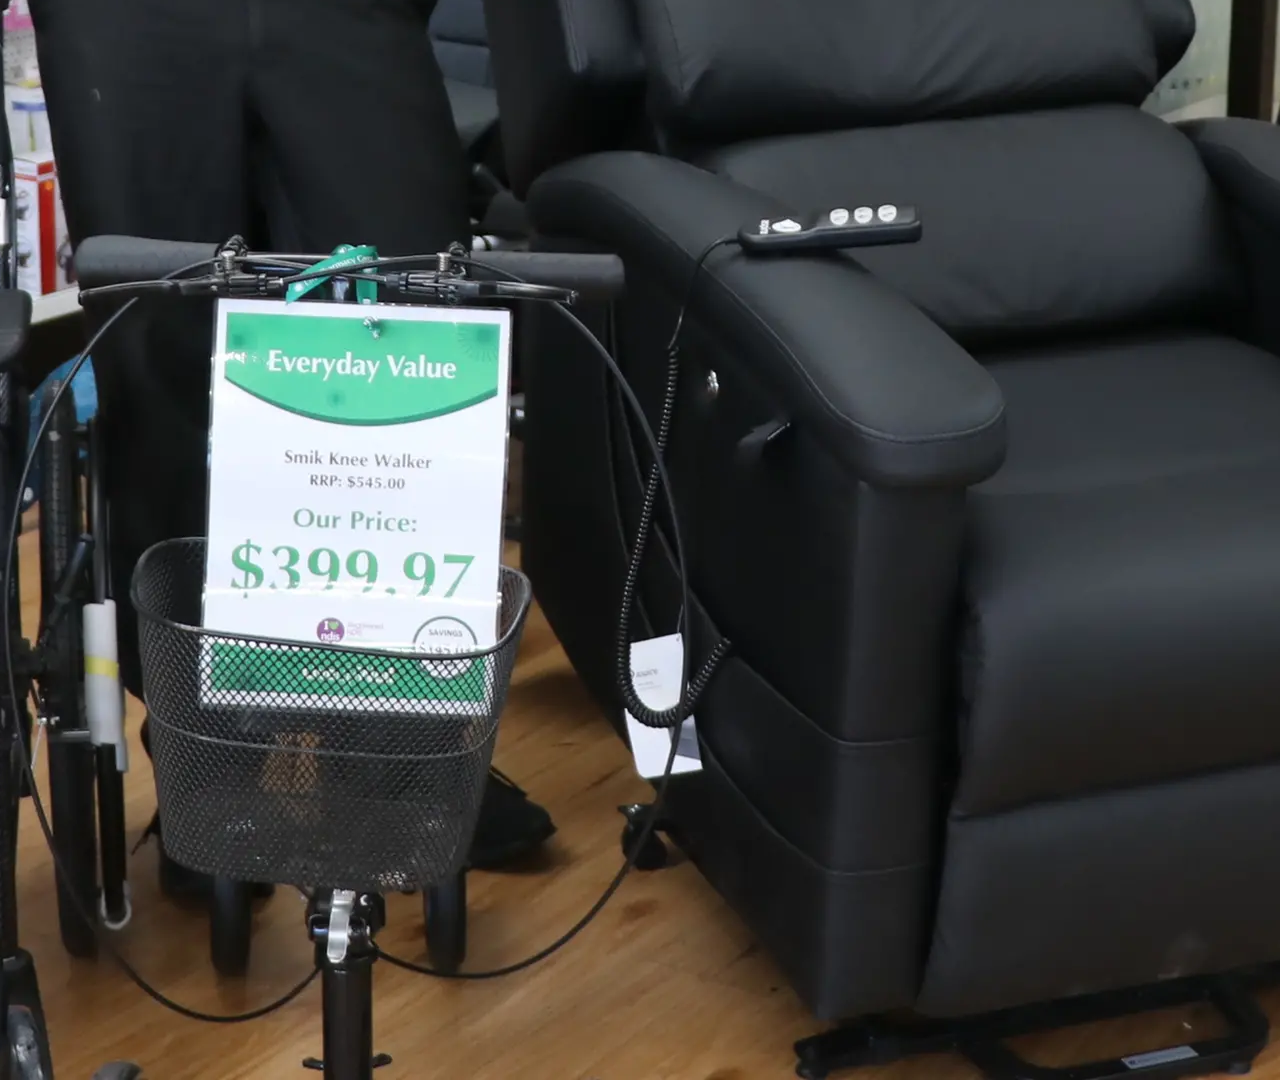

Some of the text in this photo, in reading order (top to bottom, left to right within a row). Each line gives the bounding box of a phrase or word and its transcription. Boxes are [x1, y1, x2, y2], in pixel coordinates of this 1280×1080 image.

[268, 349, 457, 383] Everyday Value
[284, 449, 433, 469] Smik Knee Walker
[309, 474, 406, 490] RRP: $545.00
[292, 507, 418, 533] Our Price:
[230, 538, 477, 599] $399.97
[320, 631, 341, 642] ndis
[428, 628, 464, 638] SAVINGS
